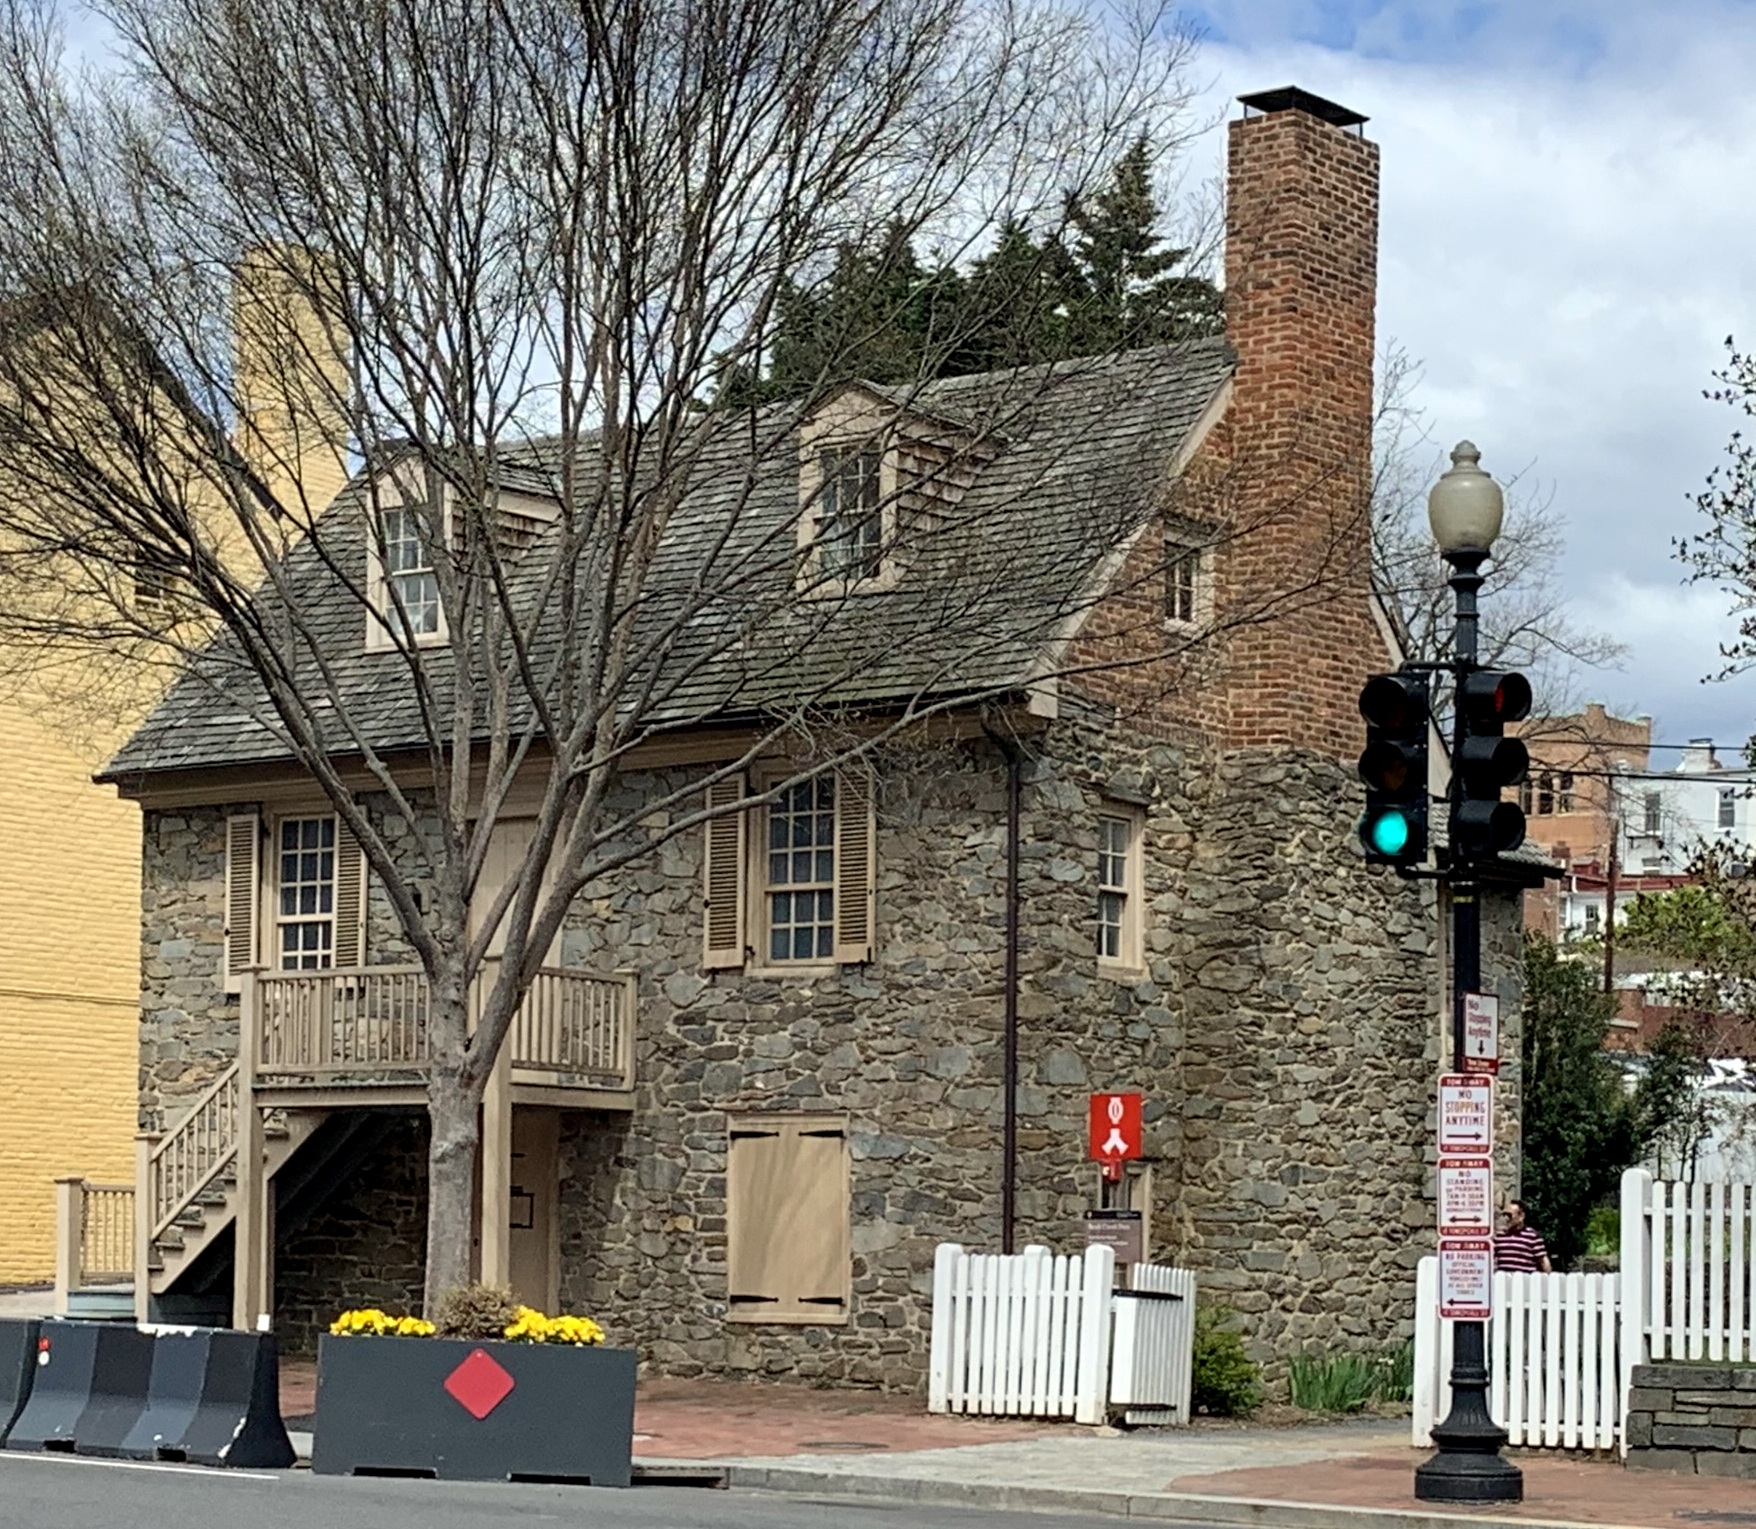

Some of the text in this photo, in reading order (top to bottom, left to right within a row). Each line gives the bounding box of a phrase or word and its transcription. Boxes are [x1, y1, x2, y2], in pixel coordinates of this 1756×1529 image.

[1458, 1089, 1472, 1099] NO
[1445, 1101, 1485, 1113] STOPPING
[1445, 1115, 1485, 1126] ANYTIME
